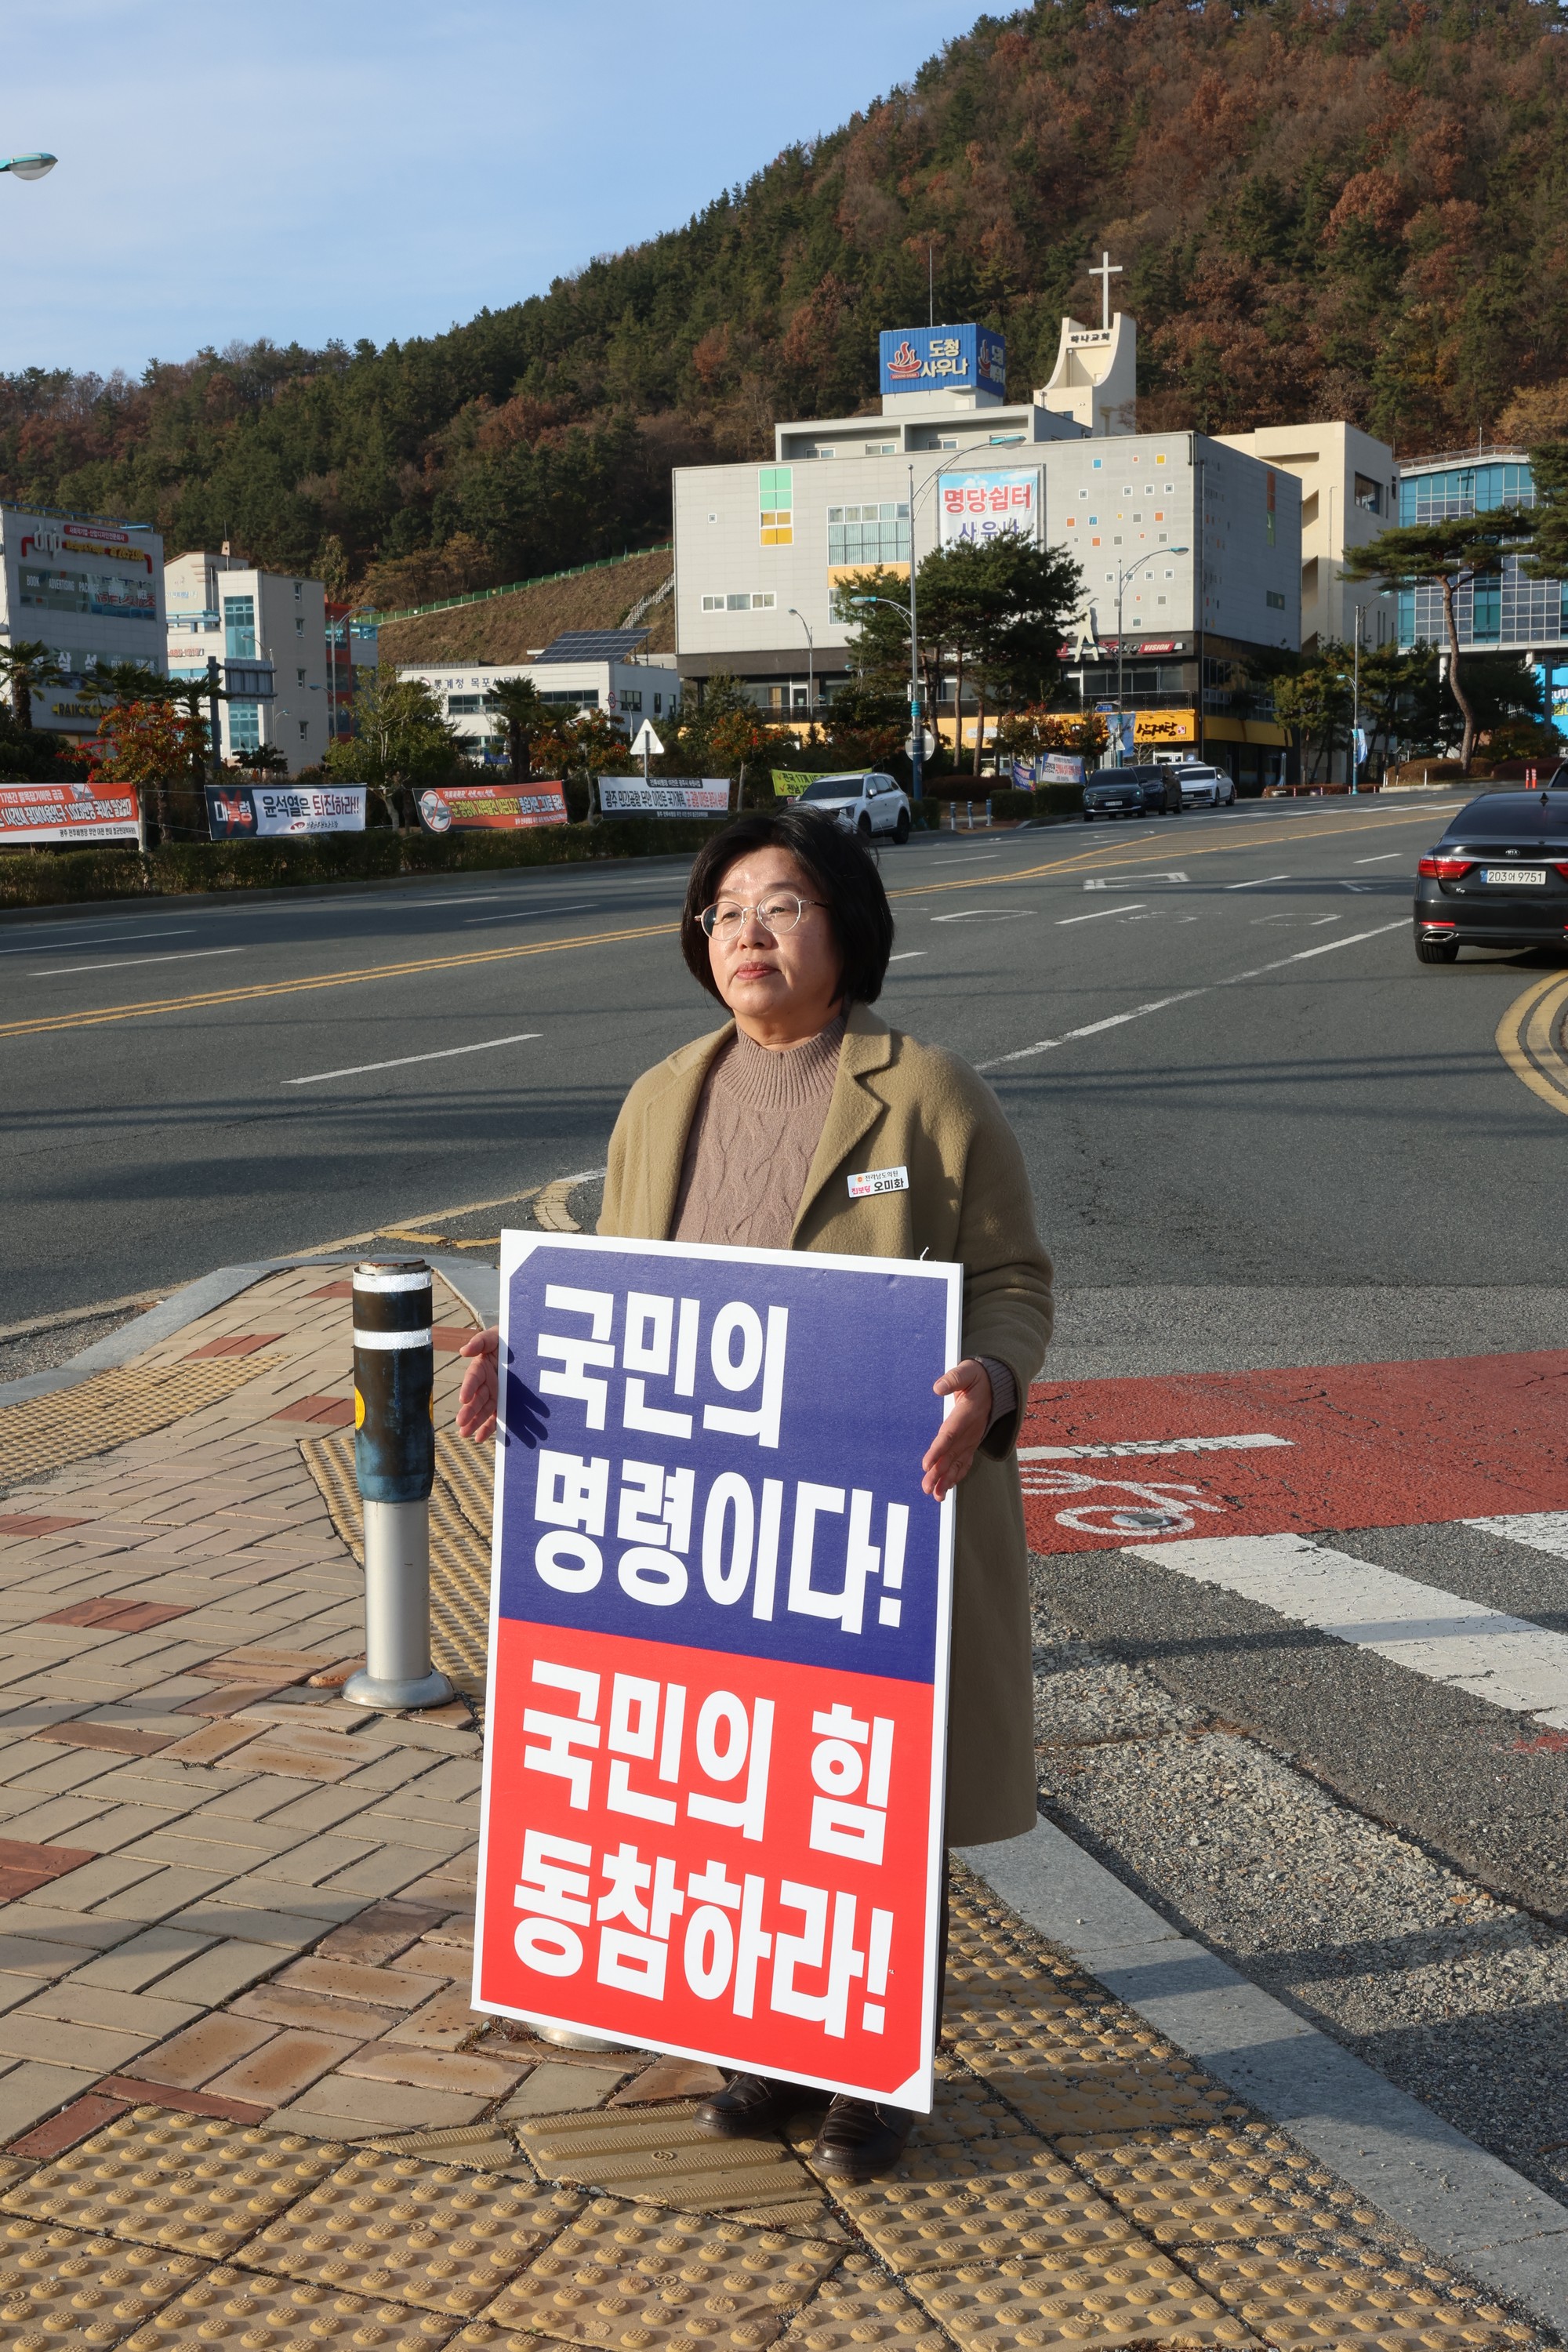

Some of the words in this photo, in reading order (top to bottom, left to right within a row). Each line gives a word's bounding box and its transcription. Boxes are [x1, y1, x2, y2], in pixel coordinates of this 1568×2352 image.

[929, 339, 960, 357] 도청
[920, 358, 969, 378] 사우나
[944, 484, 1032, 514] 명당쉼터
[27, 575, 40, 587] BOOK
[1144, 643, 1171, 652] VISION
[434, 678, 464, 689] 통계청
[1137, 721, 1178, 738] 삼계탕
[214, 800, 252, 822] 대통령
[263, 795, 311, 818] 윤석열은
[312, 794, 360, 817] 퇴진하라!!
[604, 790, 618, 808] 광주
[619, 790, 641, 808] 민간공항
[640, 790, 652, 808] 무안
[1488, 871, 1515, 882] 203어
[1518, 872, 1542, 883] 9751
[865, 1171, 898, 1181] 전라남도의원
[874, 1178, 904, 1192] 오미화
[537, 1284, 789, 1448] 국민의
[534, 1449, 909, 1635] 명령이다!
[523, 1659, 775, 1842] 국민의
[809, 1702, 895, 1866] 힘
[514, 1828, 894, 2039] 동참하라!
